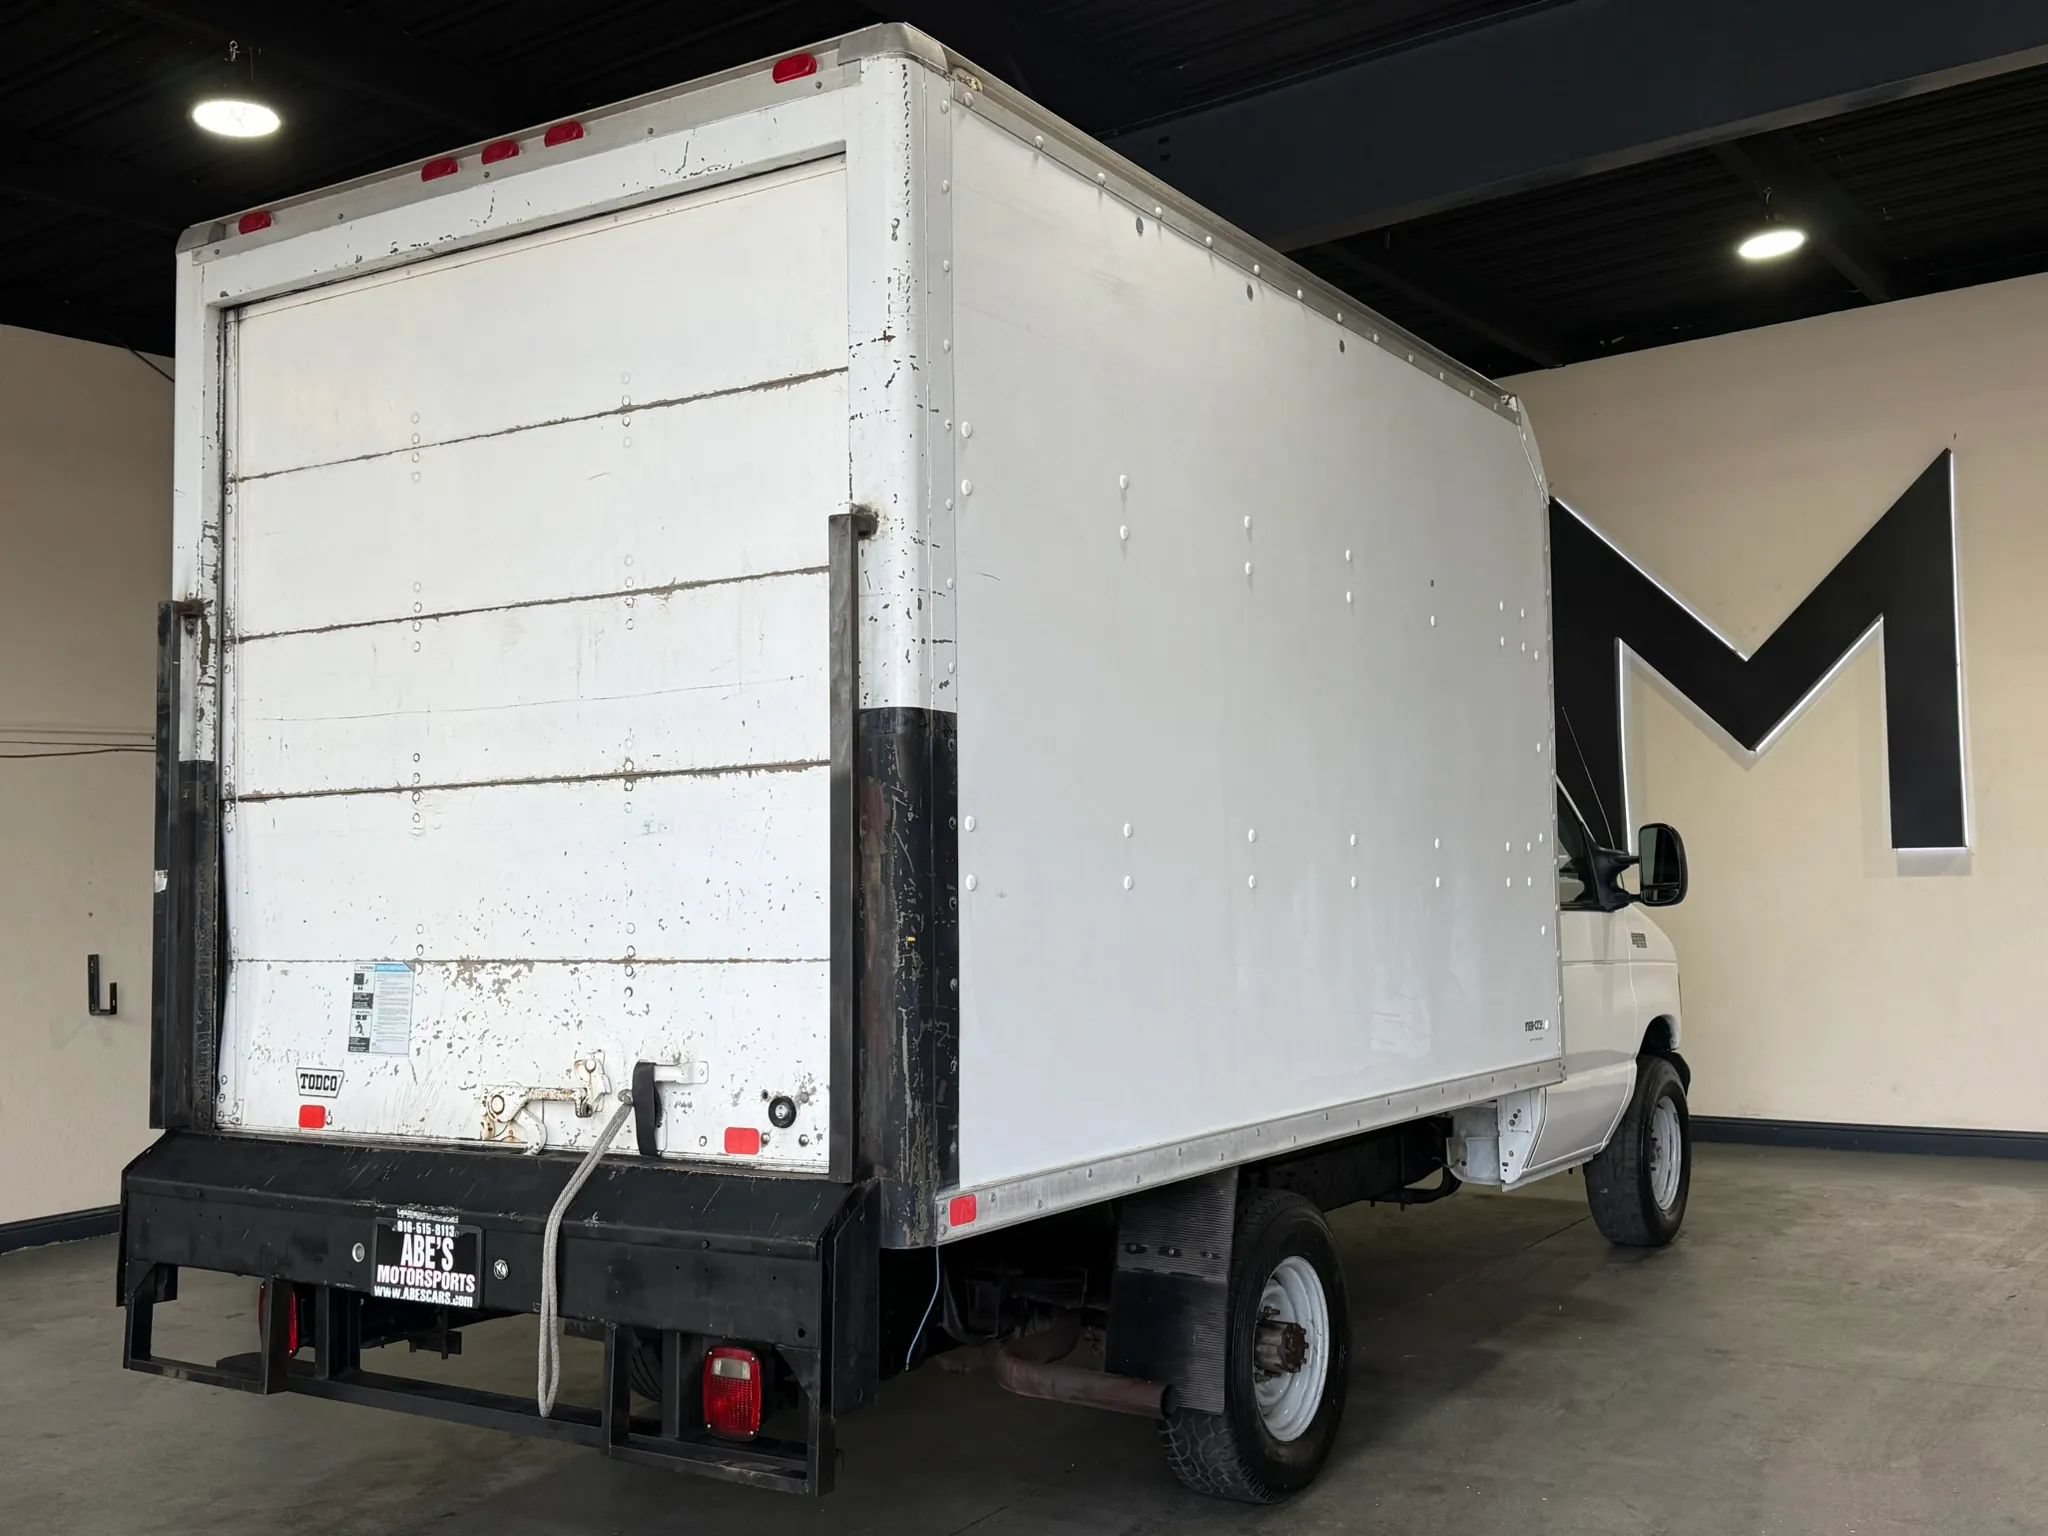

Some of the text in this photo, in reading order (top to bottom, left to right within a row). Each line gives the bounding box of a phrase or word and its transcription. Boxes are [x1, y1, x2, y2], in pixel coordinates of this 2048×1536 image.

[1549, 448, 1969, 849] M
[300, 1073, 337, 1091] TODCO
[401, 1234, 454, 1271] ABE'S
[377, 1265, 475, 1293] MOTORSPORTS
